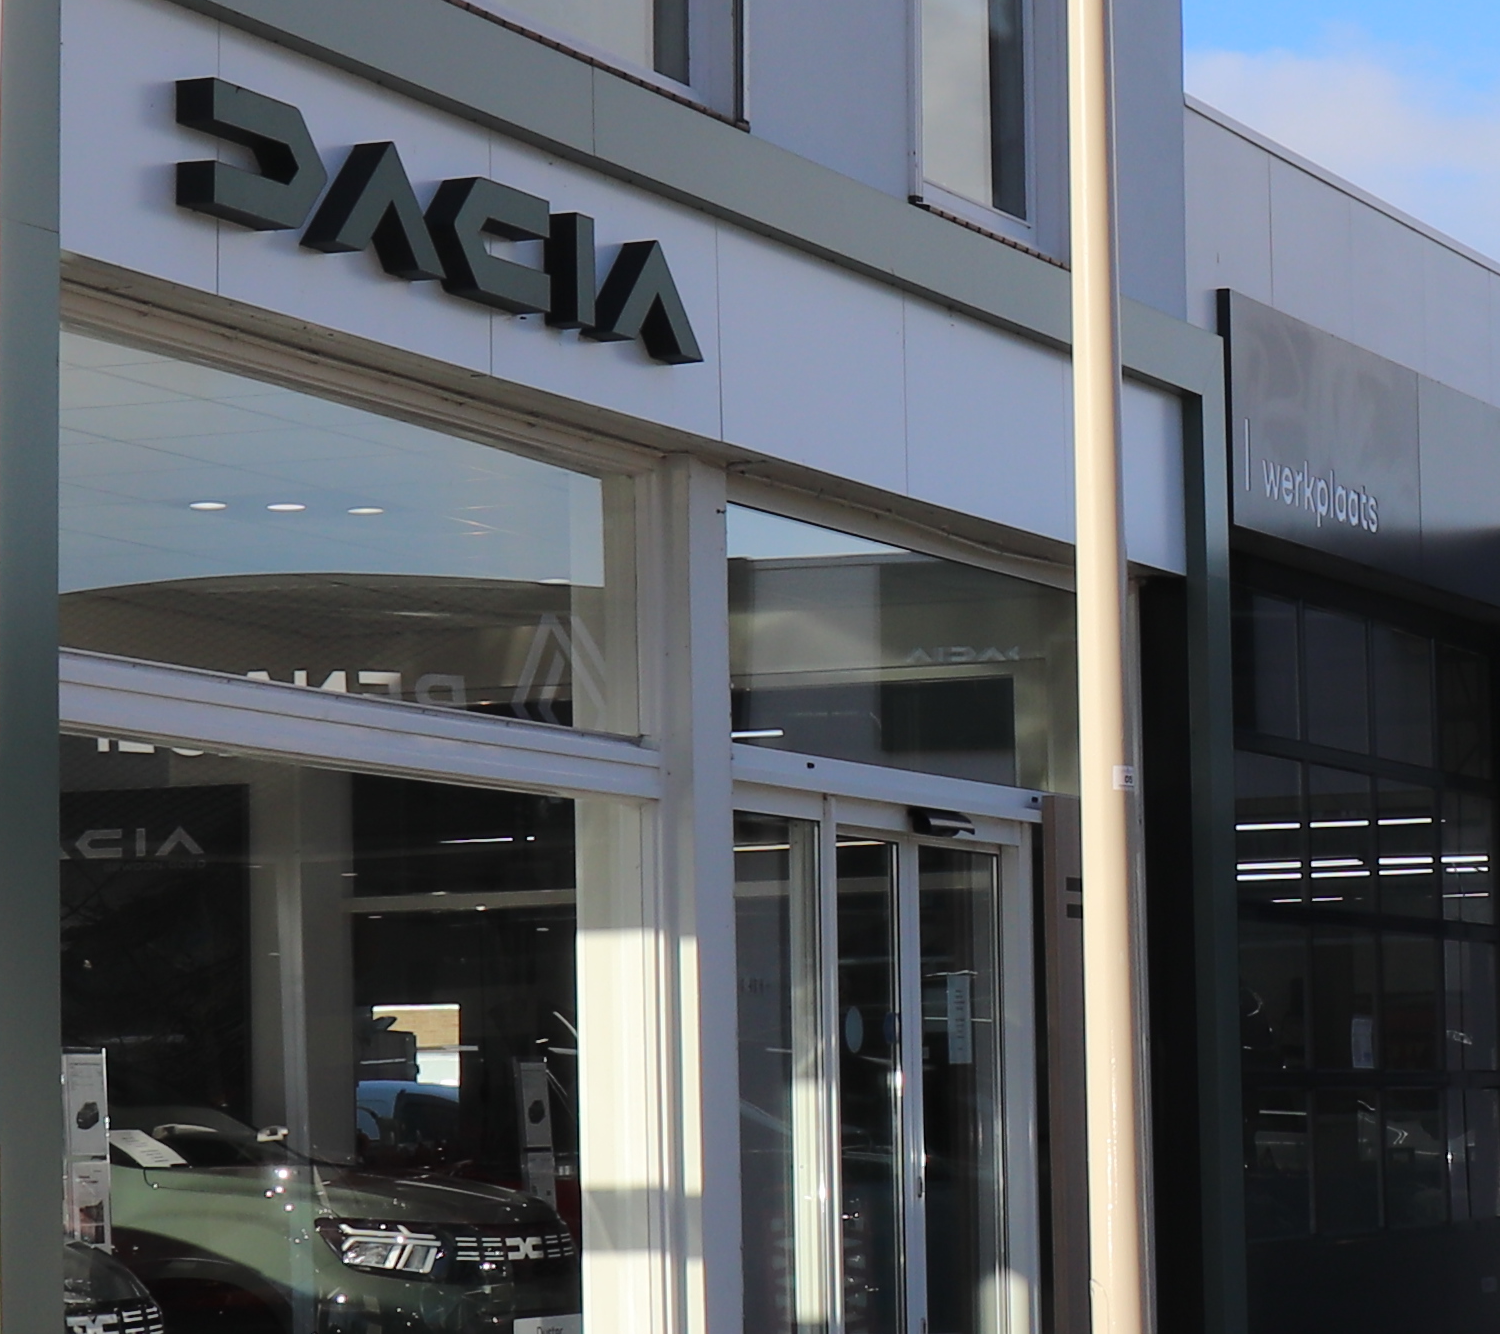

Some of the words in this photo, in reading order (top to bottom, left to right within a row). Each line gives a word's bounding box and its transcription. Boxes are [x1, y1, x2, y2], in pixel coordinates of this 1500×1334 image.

[175, 77, 704, 365] DACIA
[1262, 459, 1378, 533] werkplaats
[60, 825, 204, 860] CIA
